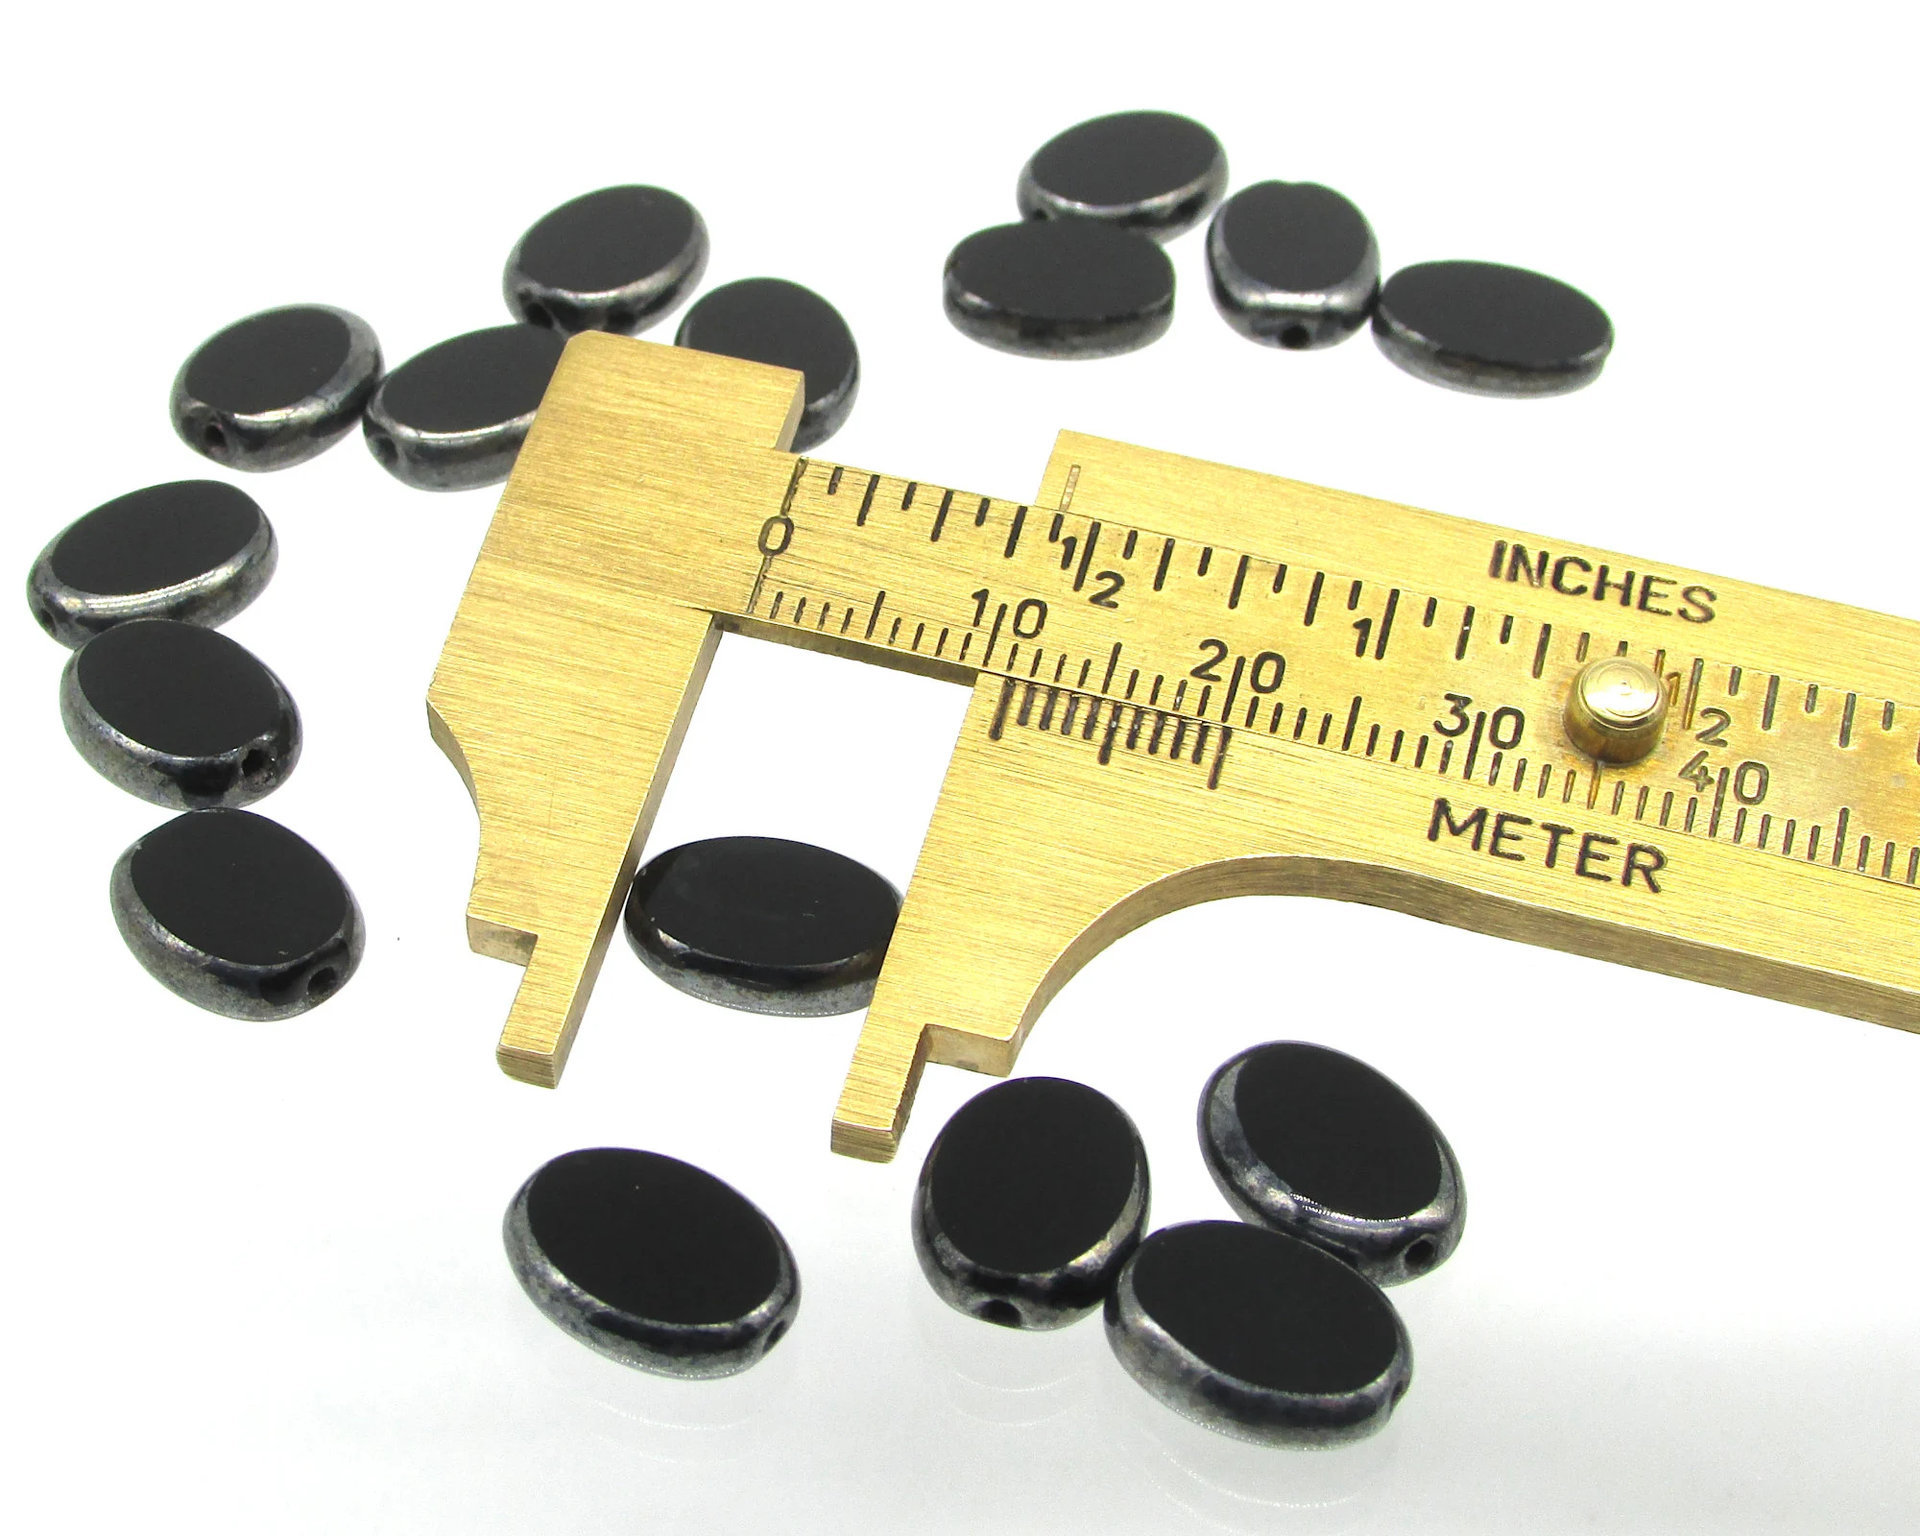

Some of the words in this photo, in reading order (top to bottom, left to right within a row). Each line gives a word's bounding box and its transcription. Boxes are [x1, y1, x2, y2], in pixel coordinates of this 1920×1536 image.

[757, 515, 795, 557] 0
[1488, 540, 1717, 623] INCHES
[1426, 797, 1669, 893] METER
